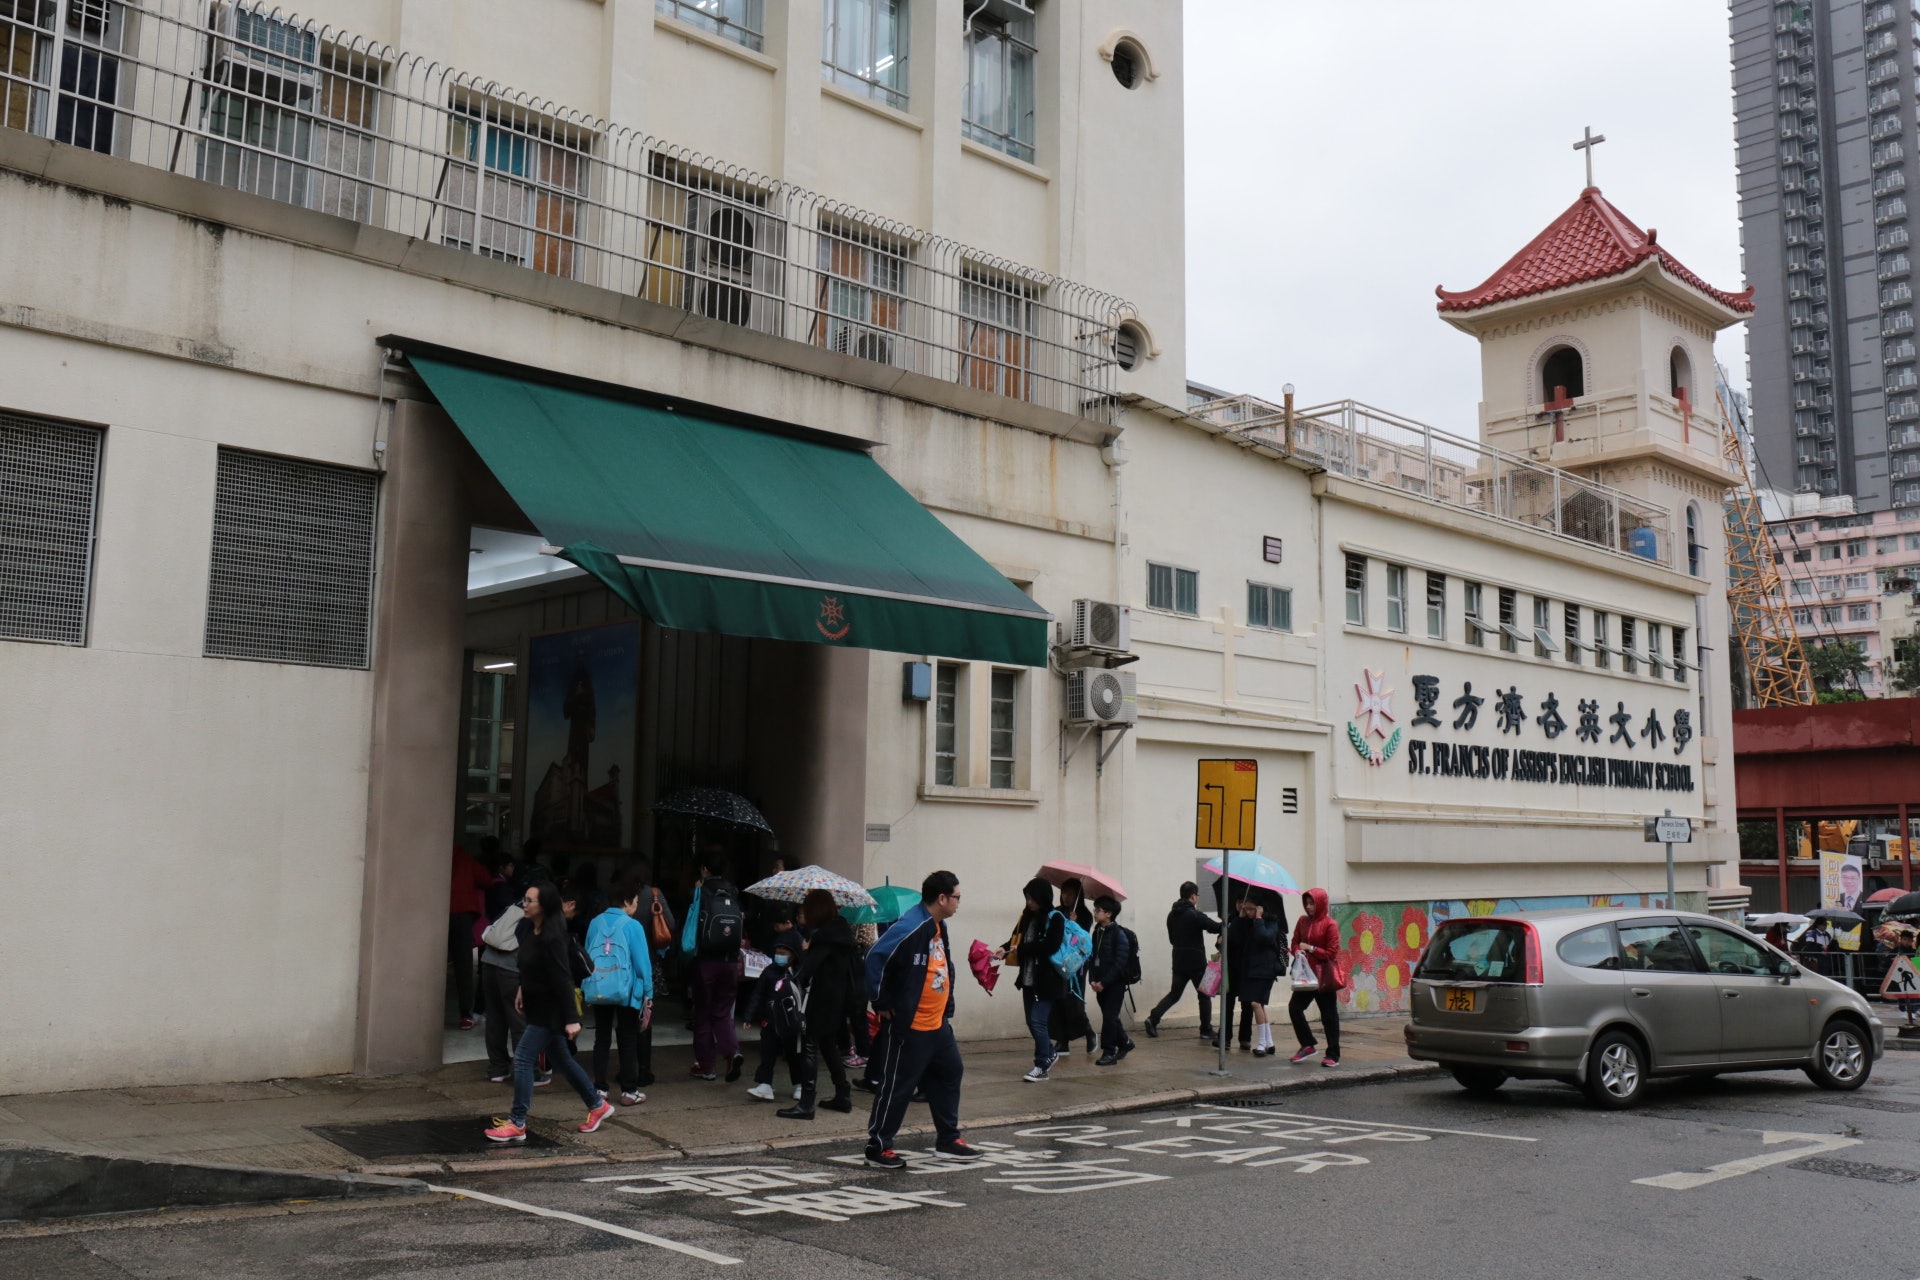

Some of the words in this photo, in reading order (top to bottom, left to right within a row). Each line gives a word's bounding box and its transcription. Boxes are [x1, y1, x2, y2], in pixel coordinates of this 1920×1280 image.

[1411, 675, 1692, 755] 聖方濟各英文小學
[1408, 740, 1430, 774] ST.
[1432, 742, 1490, 779] FRANCIS
[1492, 747, 1509, 780] OF
[1559, 754, 1606, 786] ENGLISH
[1607, 758, 1654, 789] PRIMARY
[1655, 762, 1694, 792] SCHOOL
[1449, 1000, 1471, 1011] 7122
[1453, 990, 1467, 1000] LE
[1015, 1125, 1370, 1173] CLEAR
[1141, 1113, 1431, 1144] KEEP
[582, 1166, 966, 1221] 停車
